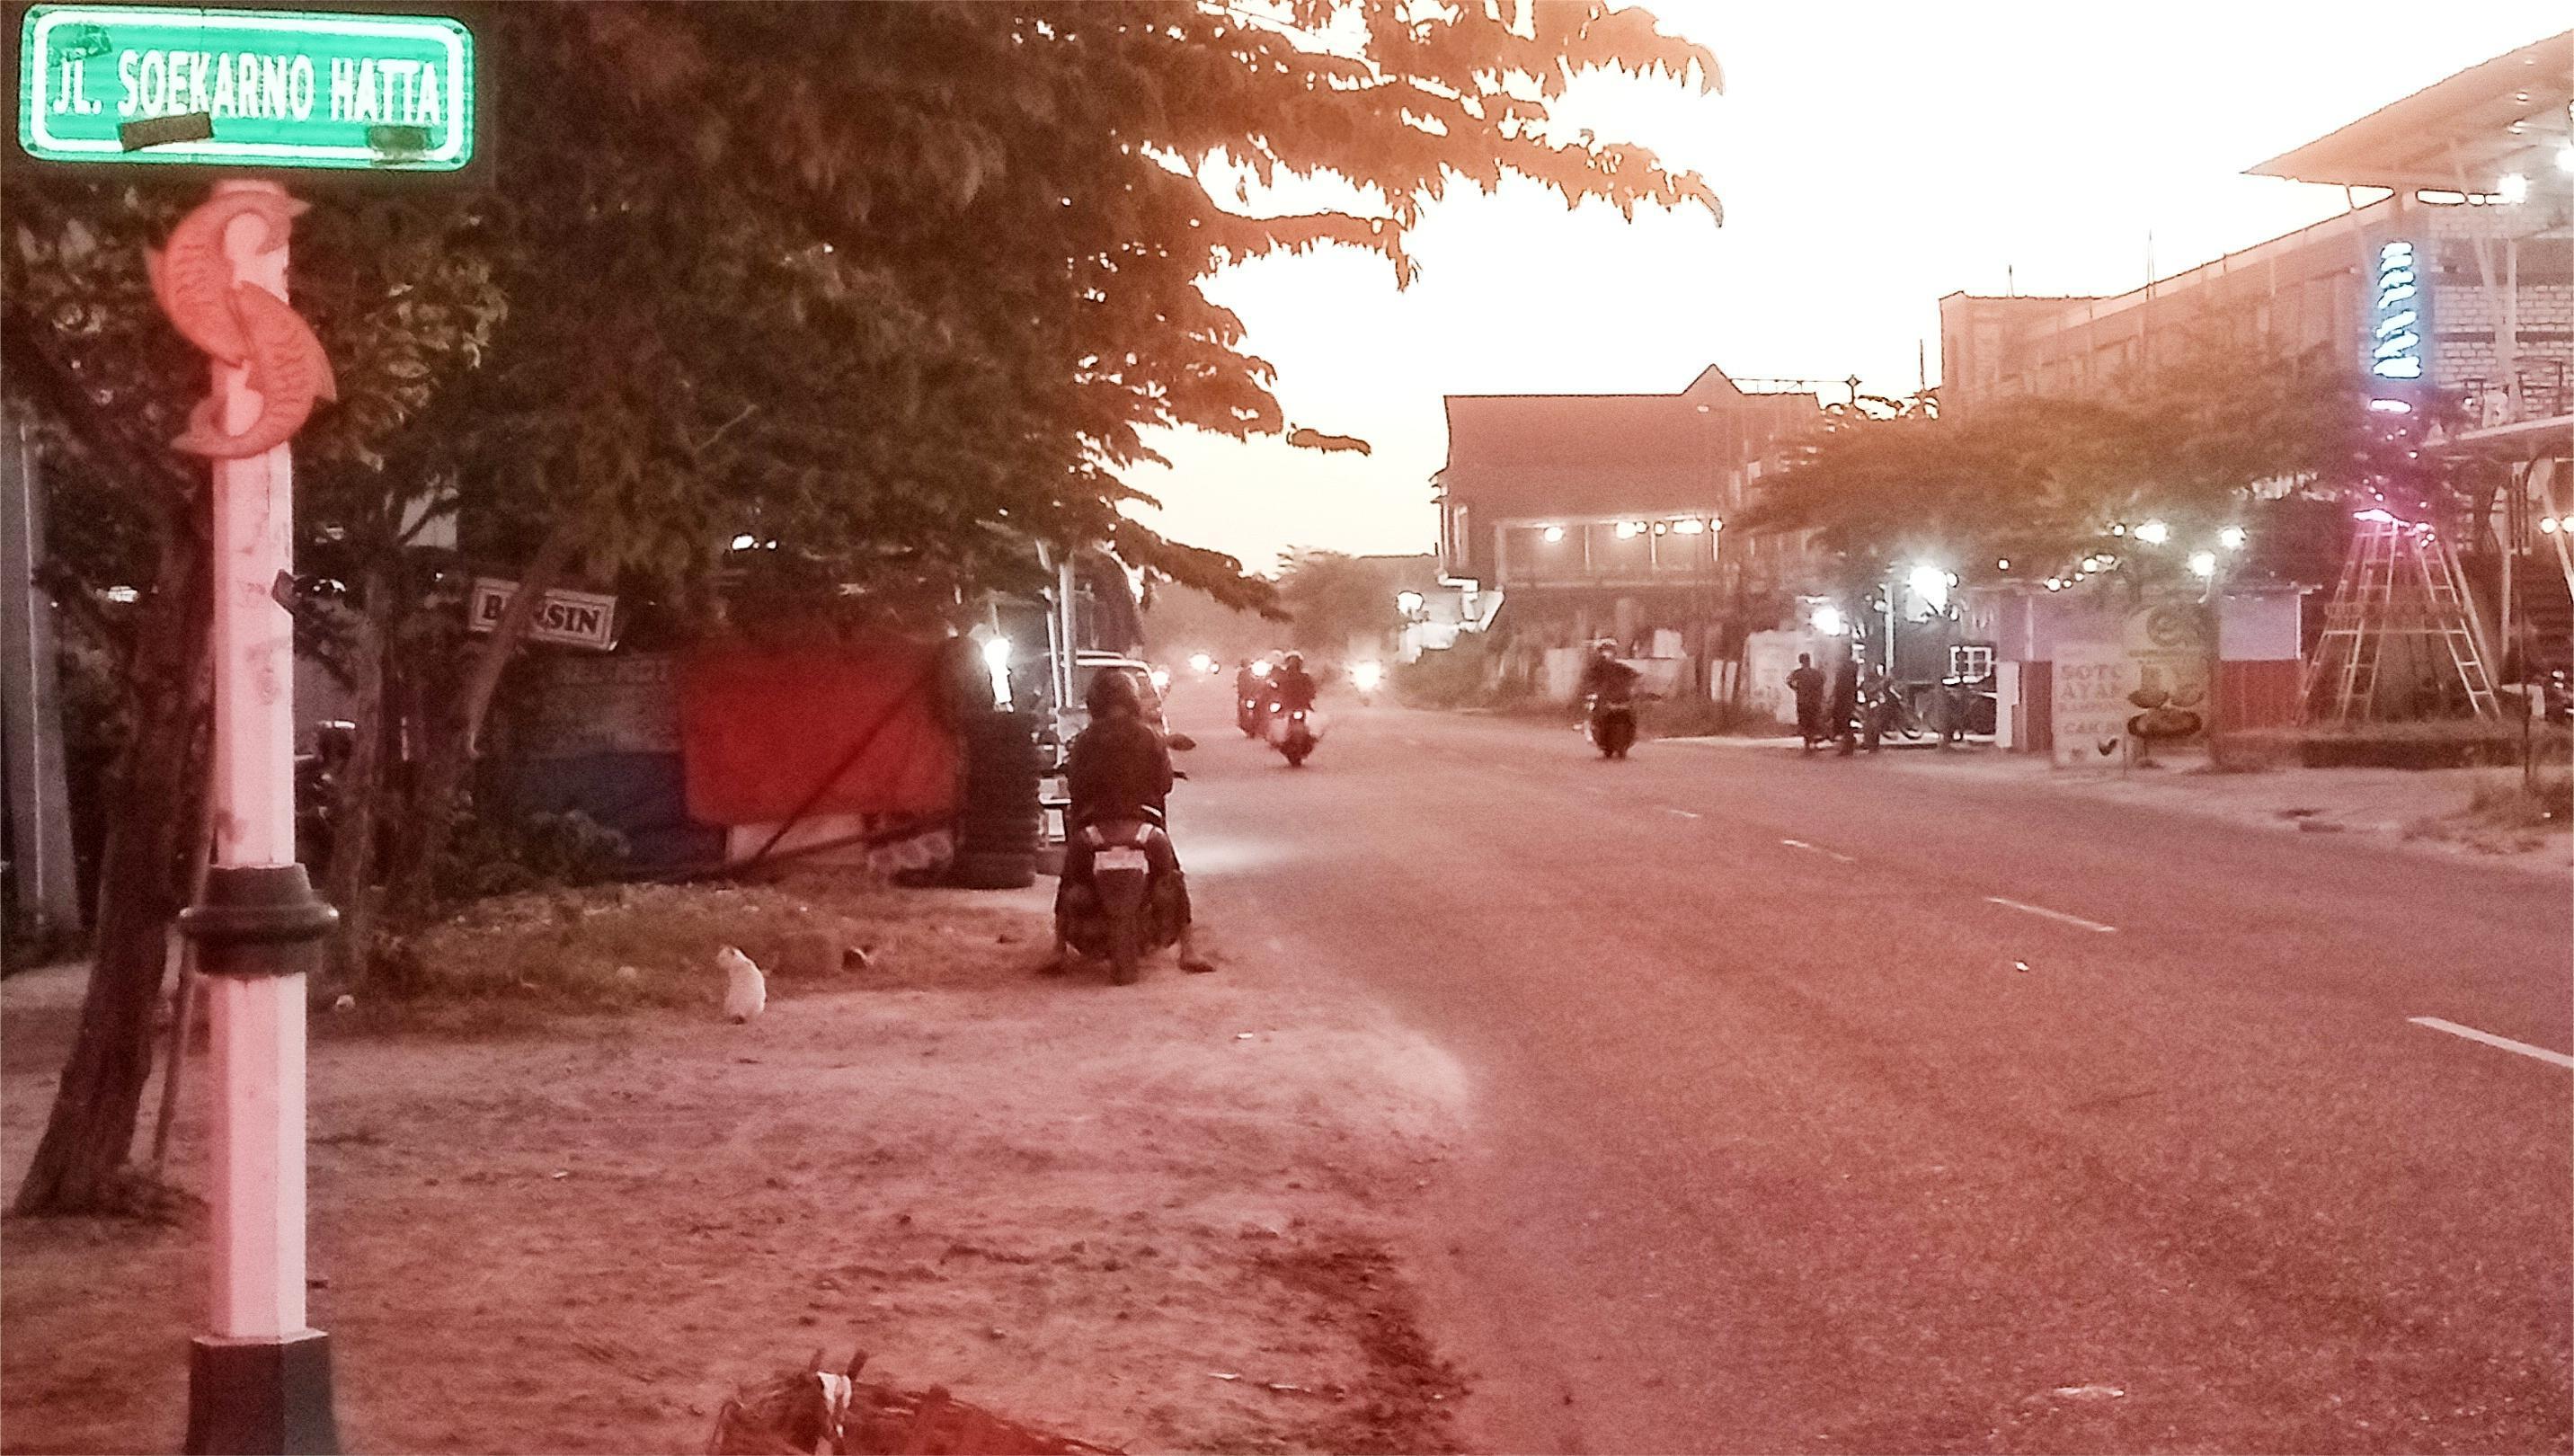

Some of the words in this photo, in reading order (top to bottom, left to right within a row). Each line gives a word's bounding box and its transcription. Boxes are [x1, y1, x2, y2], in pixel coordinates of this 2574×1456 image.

[52, 51, 103, 116] JL.
[117, 49, 316, 122] SOEKARNO
[330, 57, 441, 127] HATTA
[482, 593, 601, 635] BSIN
